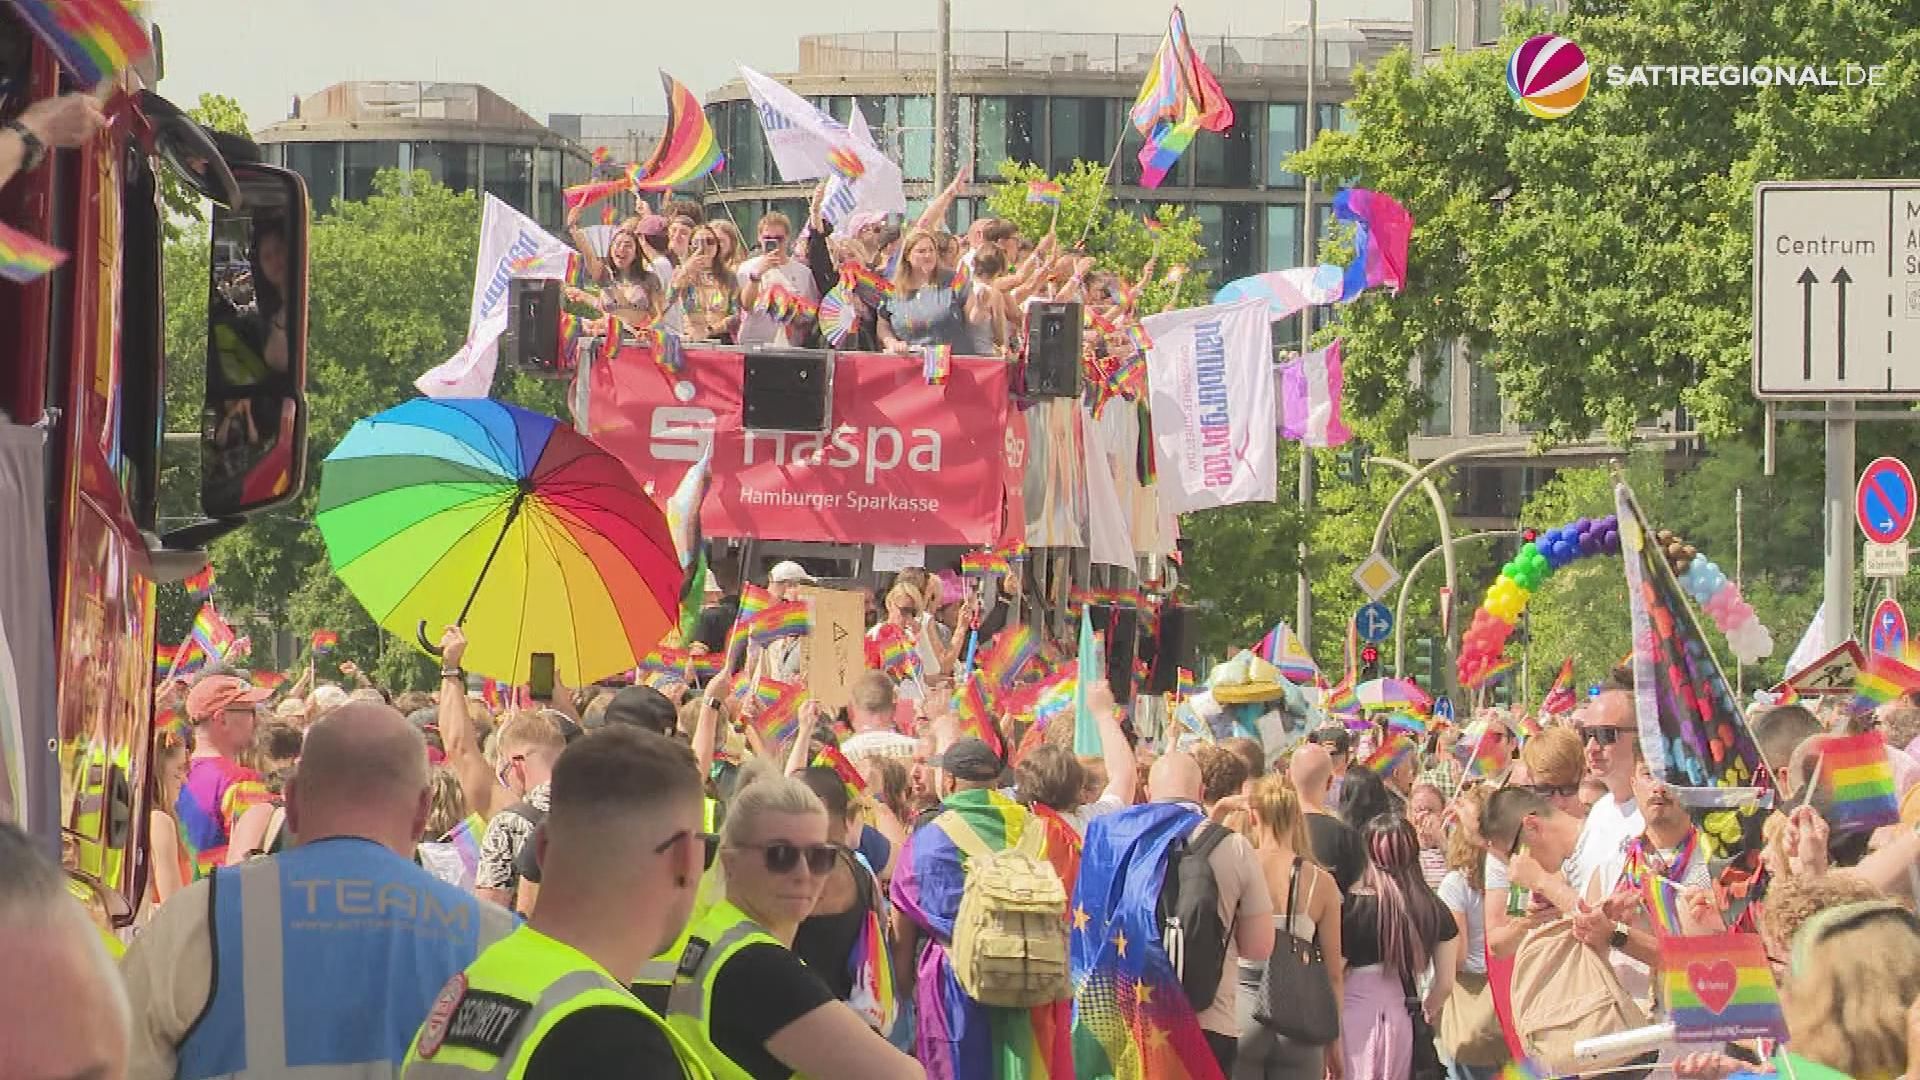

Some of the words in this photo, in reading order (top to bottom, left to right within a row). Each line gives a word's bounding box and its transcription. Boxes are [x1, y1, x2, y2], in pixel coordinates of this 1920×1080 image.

[1776, 234, 1876, 255] Centrum
[739, 486, 842, 511] Hamburger
[847, 490, 939, 512] Sparkasse
[290, 879, 470, 930] TEAM
